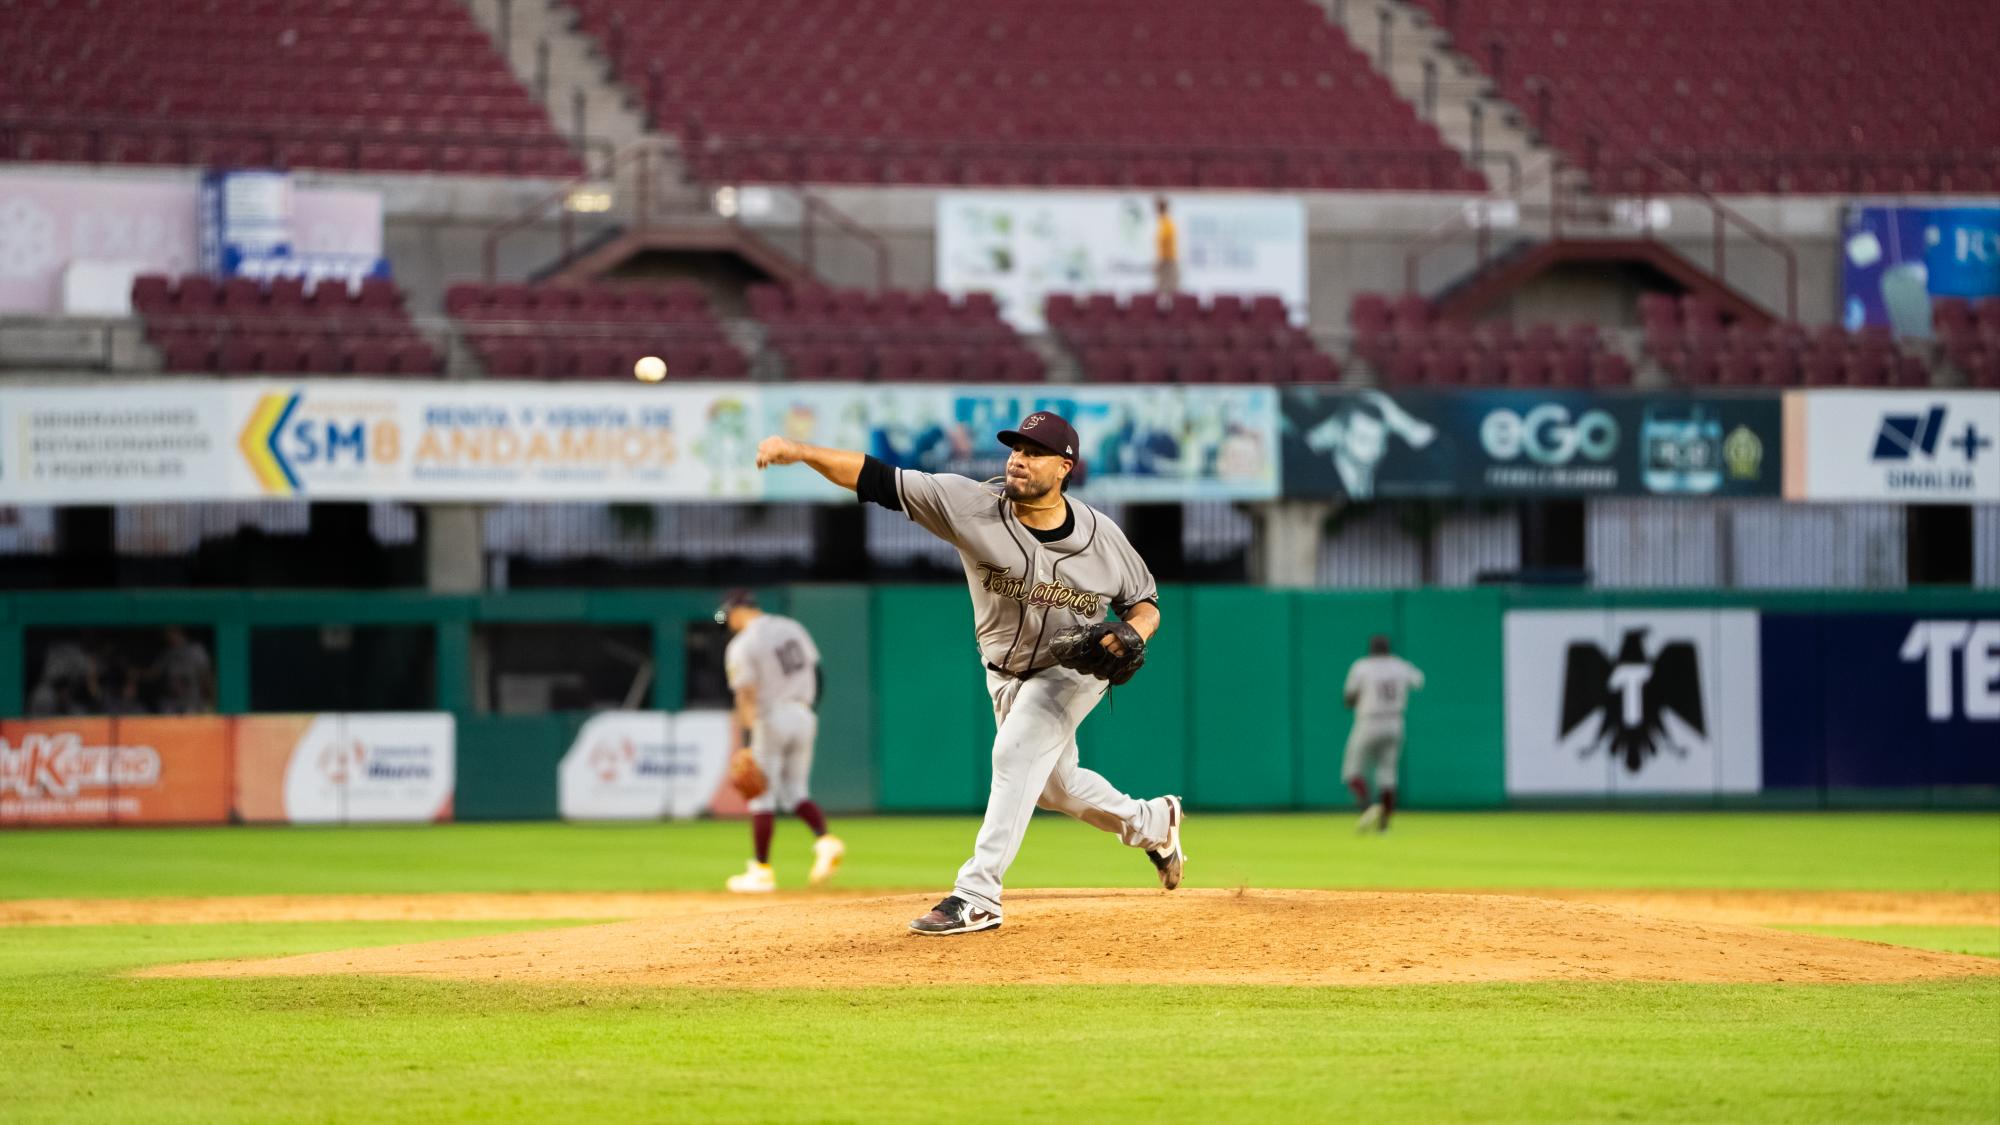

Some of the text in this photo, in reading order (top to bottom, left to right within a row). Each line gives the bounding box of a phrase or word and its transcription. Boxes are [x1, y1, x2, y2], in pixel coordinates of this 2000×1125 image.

[423, 405, 509, 427] RENTA
[1479, 402, 1621, 466] eGo
[414, 428, 677, 467] ANDAMIOS
[1887, 470, 1973, 489] SINALOA
[977, 561, 1101, 618] Tomateros
[776, 639, 804, 676] 10
[1608, 663, 1653, 727] T
